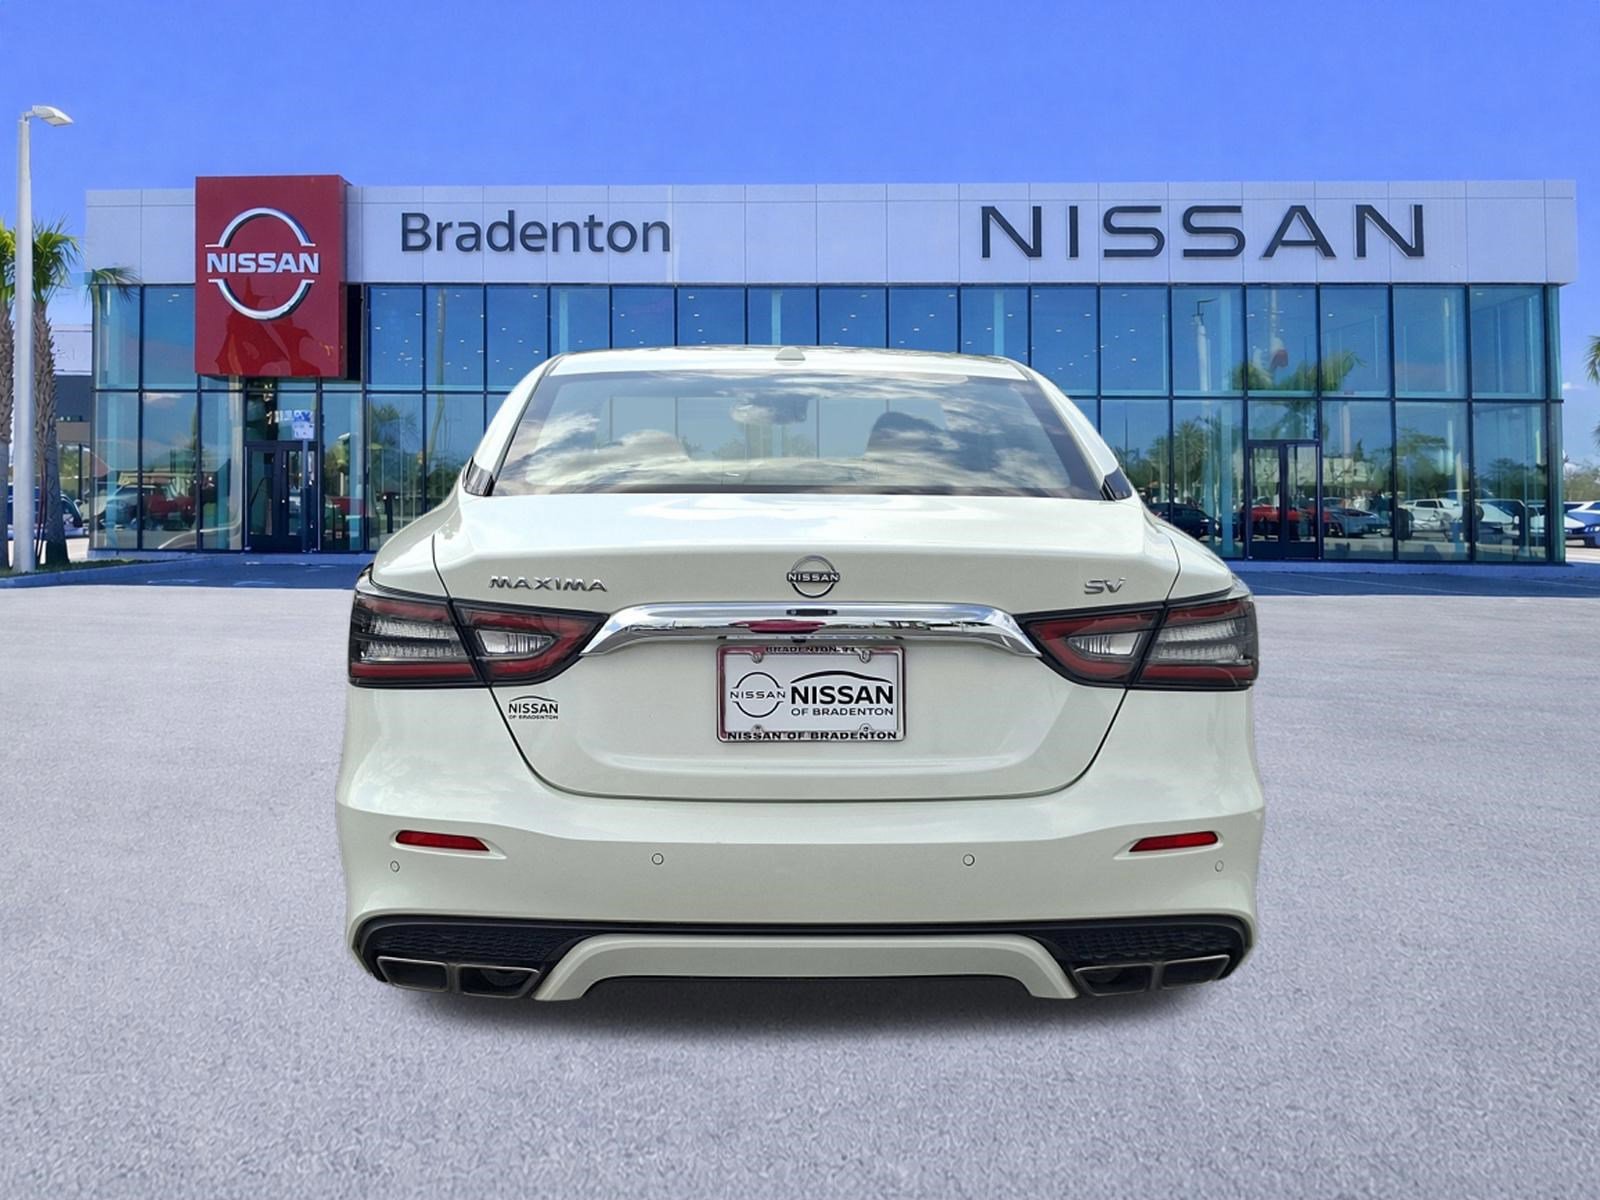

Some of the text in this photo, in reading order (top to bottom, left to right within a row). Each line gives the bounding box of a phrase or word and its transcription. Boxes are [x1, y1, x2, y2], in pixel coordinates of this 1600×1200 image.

[400, 210, 671, 253] Bradenton
[980, 203, 1425, 259] NISSAN
[206, 252, 319, 274] NISSAN
[489, 575, 608, 592] MAXIMA
[787, 572, 840, 581] NISSAN
[1083, 577, 1126, 595] SV
[729, 690, 787, 700] NISSAN
[790, 685, 894, 705] NISSAN
[508, 703, 560, 714] NISSAN
[790, 707, 894, 717] OF BRADENTON
[727, 731, 898, 741] NISSAN OF BRADENTON
